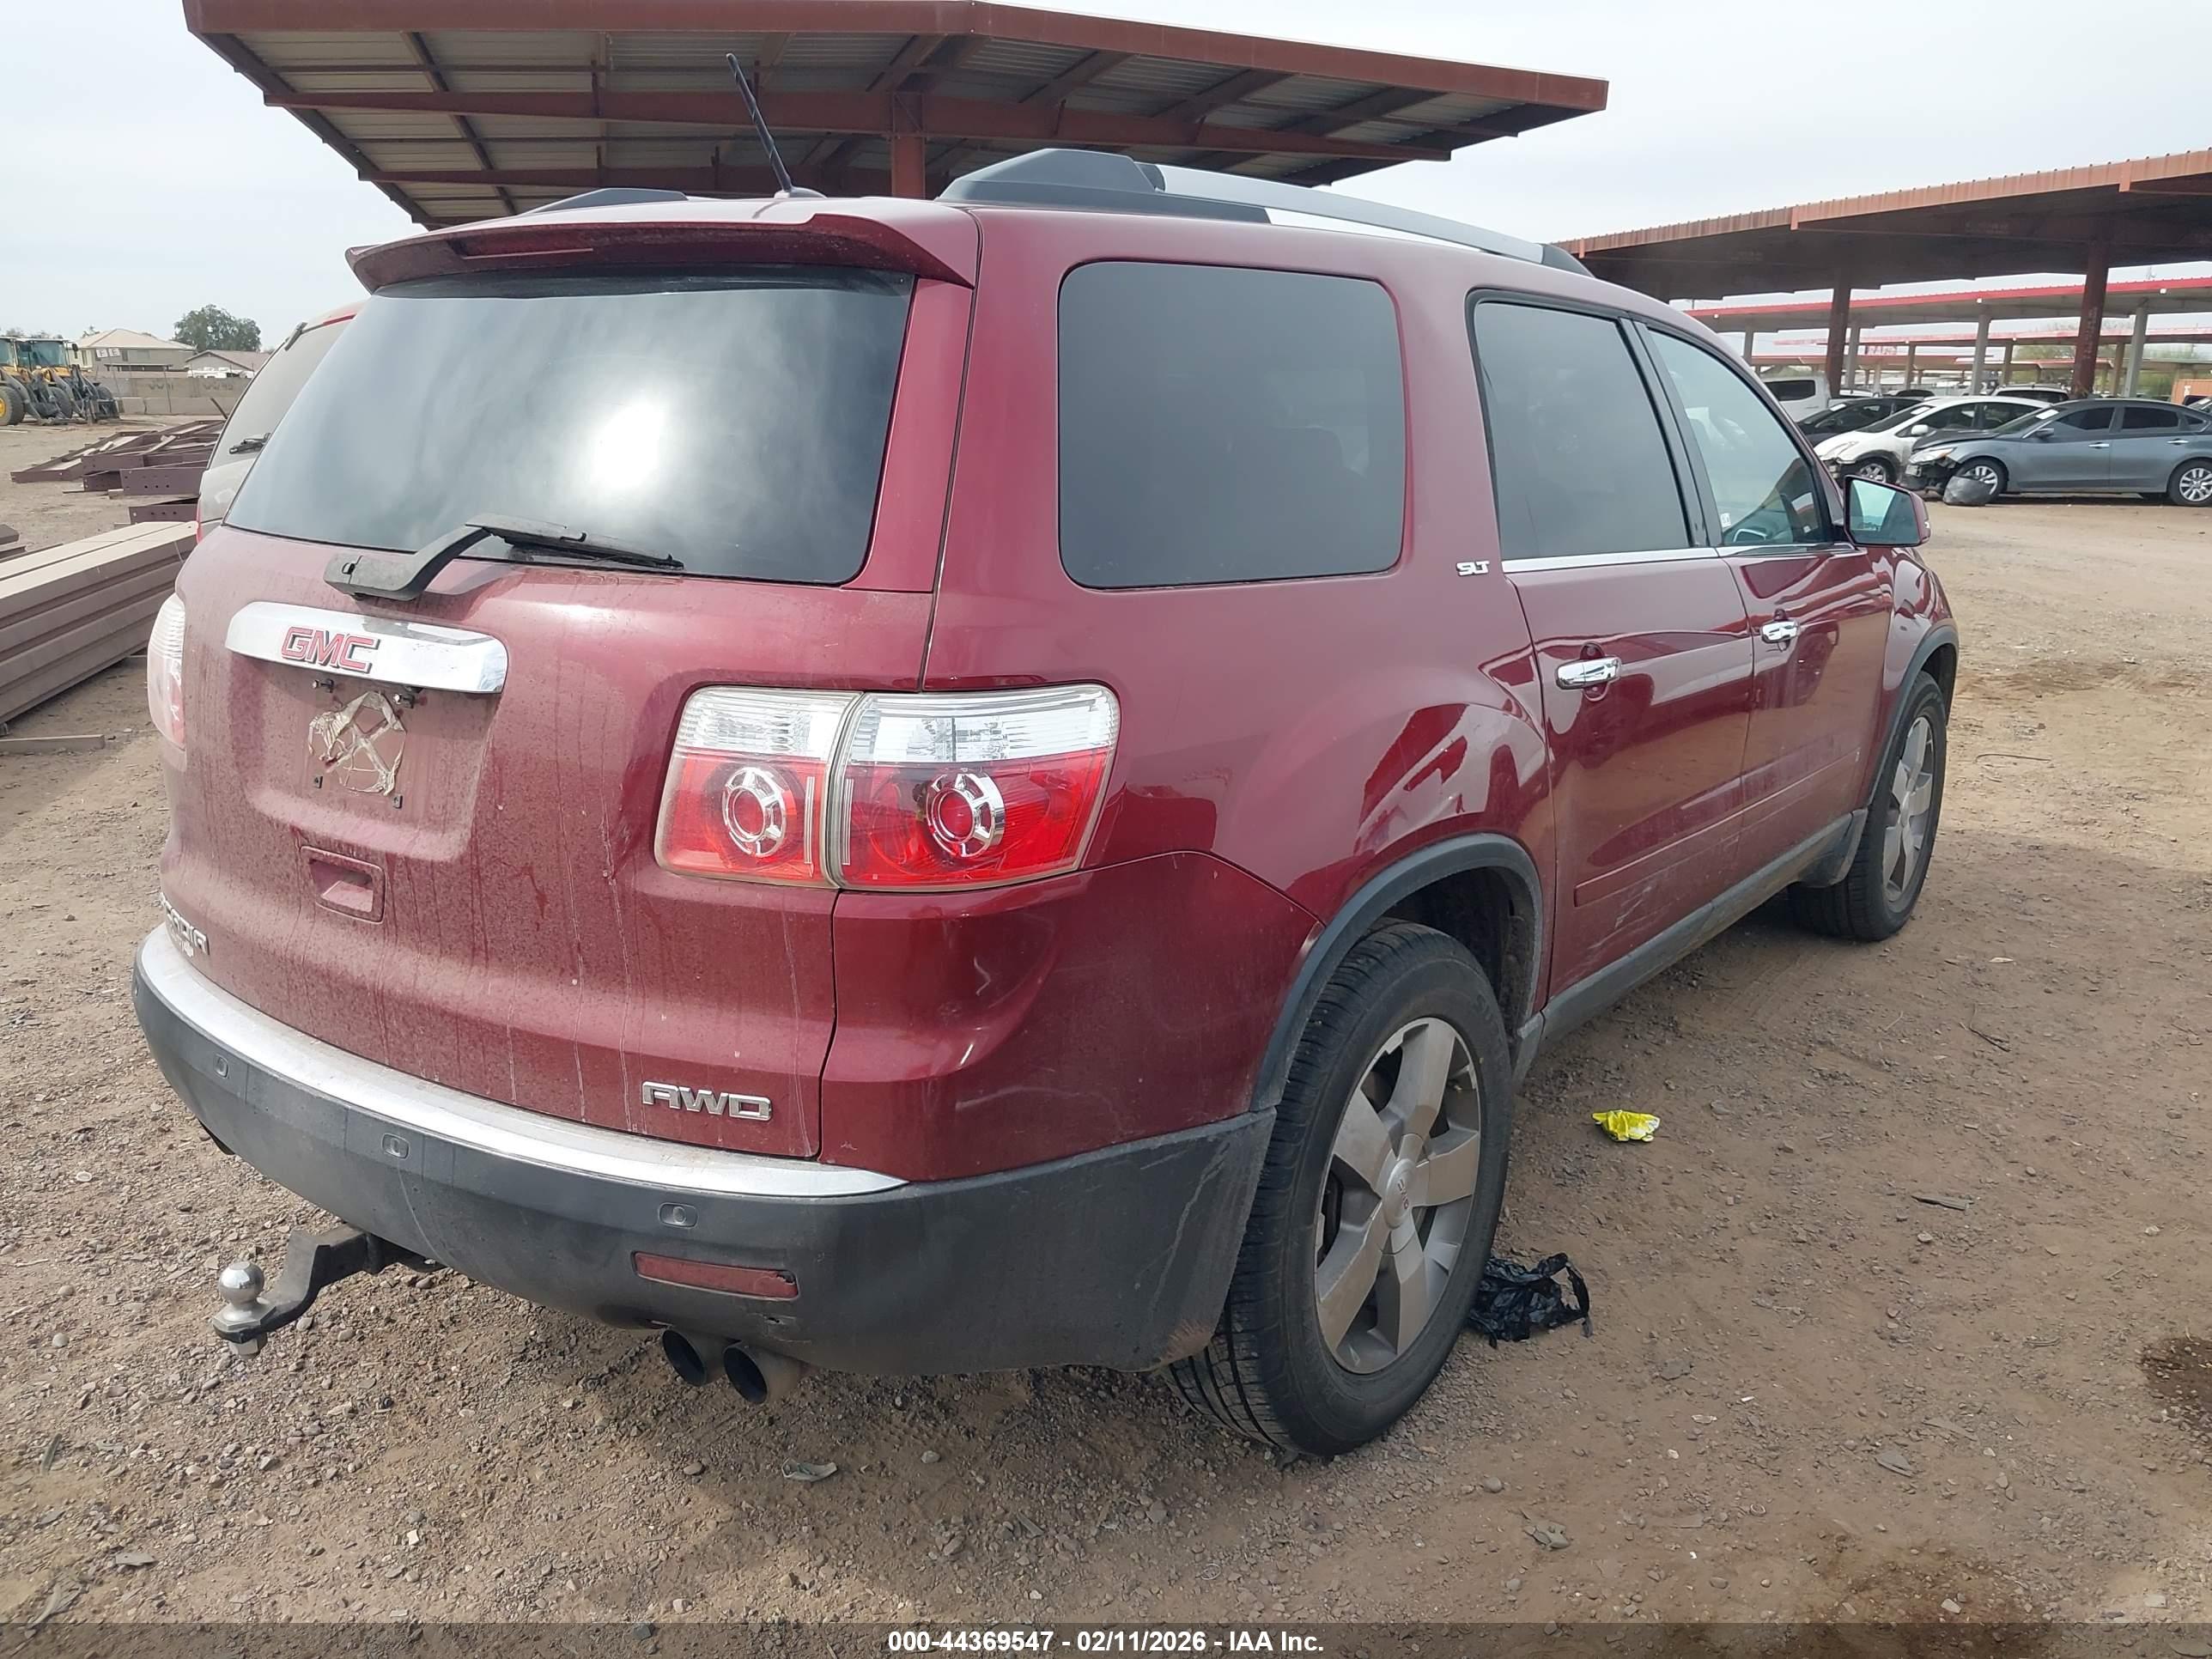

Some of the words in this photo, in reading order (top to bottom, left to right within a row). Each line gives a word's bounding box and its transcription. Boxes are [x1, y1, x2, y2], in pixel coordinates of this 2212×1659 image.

[1455, 561, 1490, 576] SLT
[281, 626, 380, 674] GMC
[642, 1081, 772, 1121] AWD
